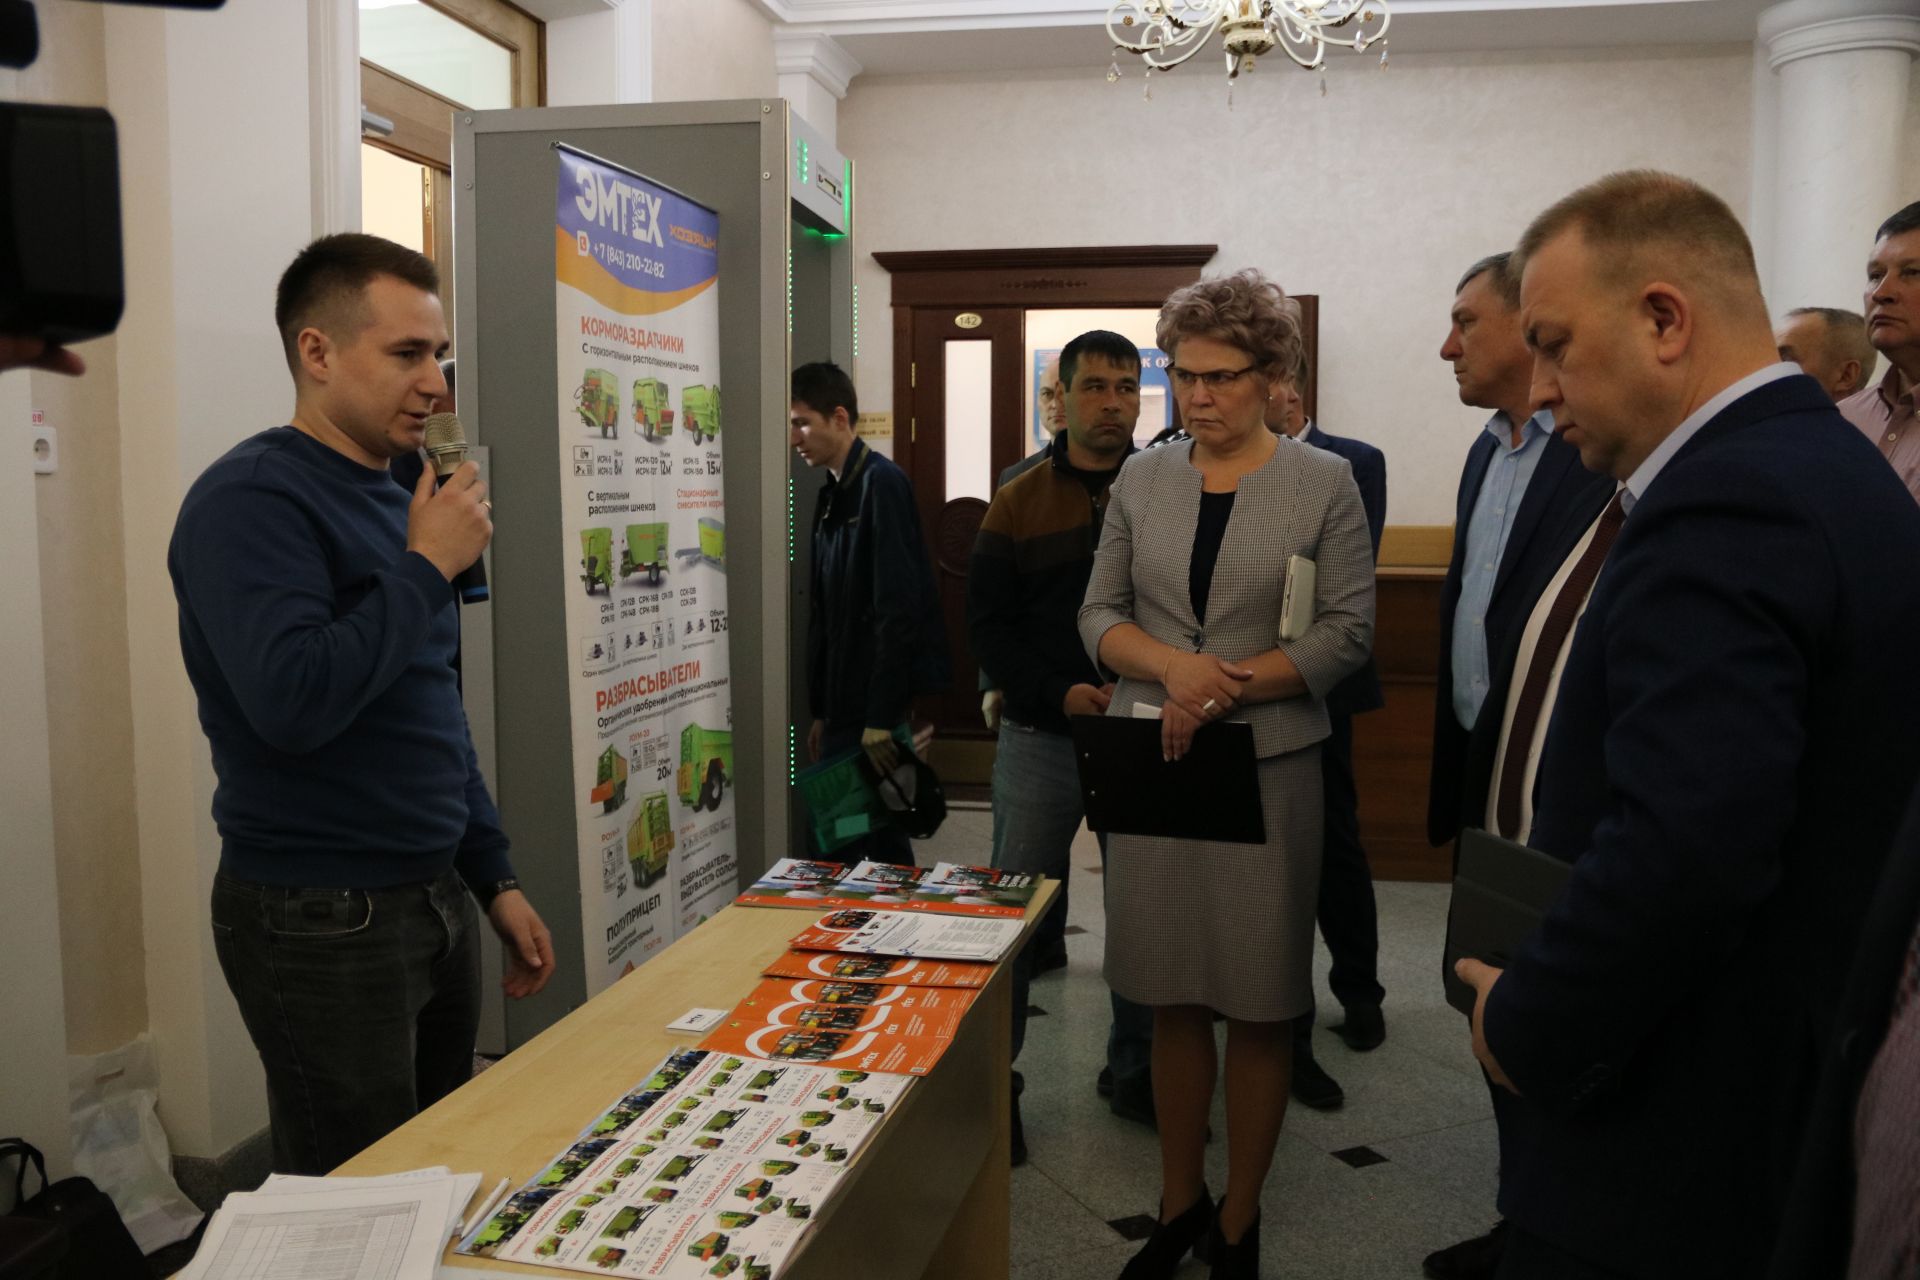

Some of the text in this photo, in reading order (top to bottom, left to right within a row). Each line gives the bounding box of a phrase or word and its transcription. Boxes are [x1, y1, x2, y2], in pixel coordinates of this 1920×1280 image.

[575, 166, 664, 248] ЭМТЕХ
[581, 316, 684, 353] КОРМОРАЗДАТЧИКИ
[960, 316, 977, 326] 142
[630, 502, 656, 513] шнеков
[596, 660, 700, 712] РАЗБРАСЫВАТЕЛИ
[632, 696, 668, 715] удобрений
[606, 894, 661, 942] ПОЛУПРИЦЕП
